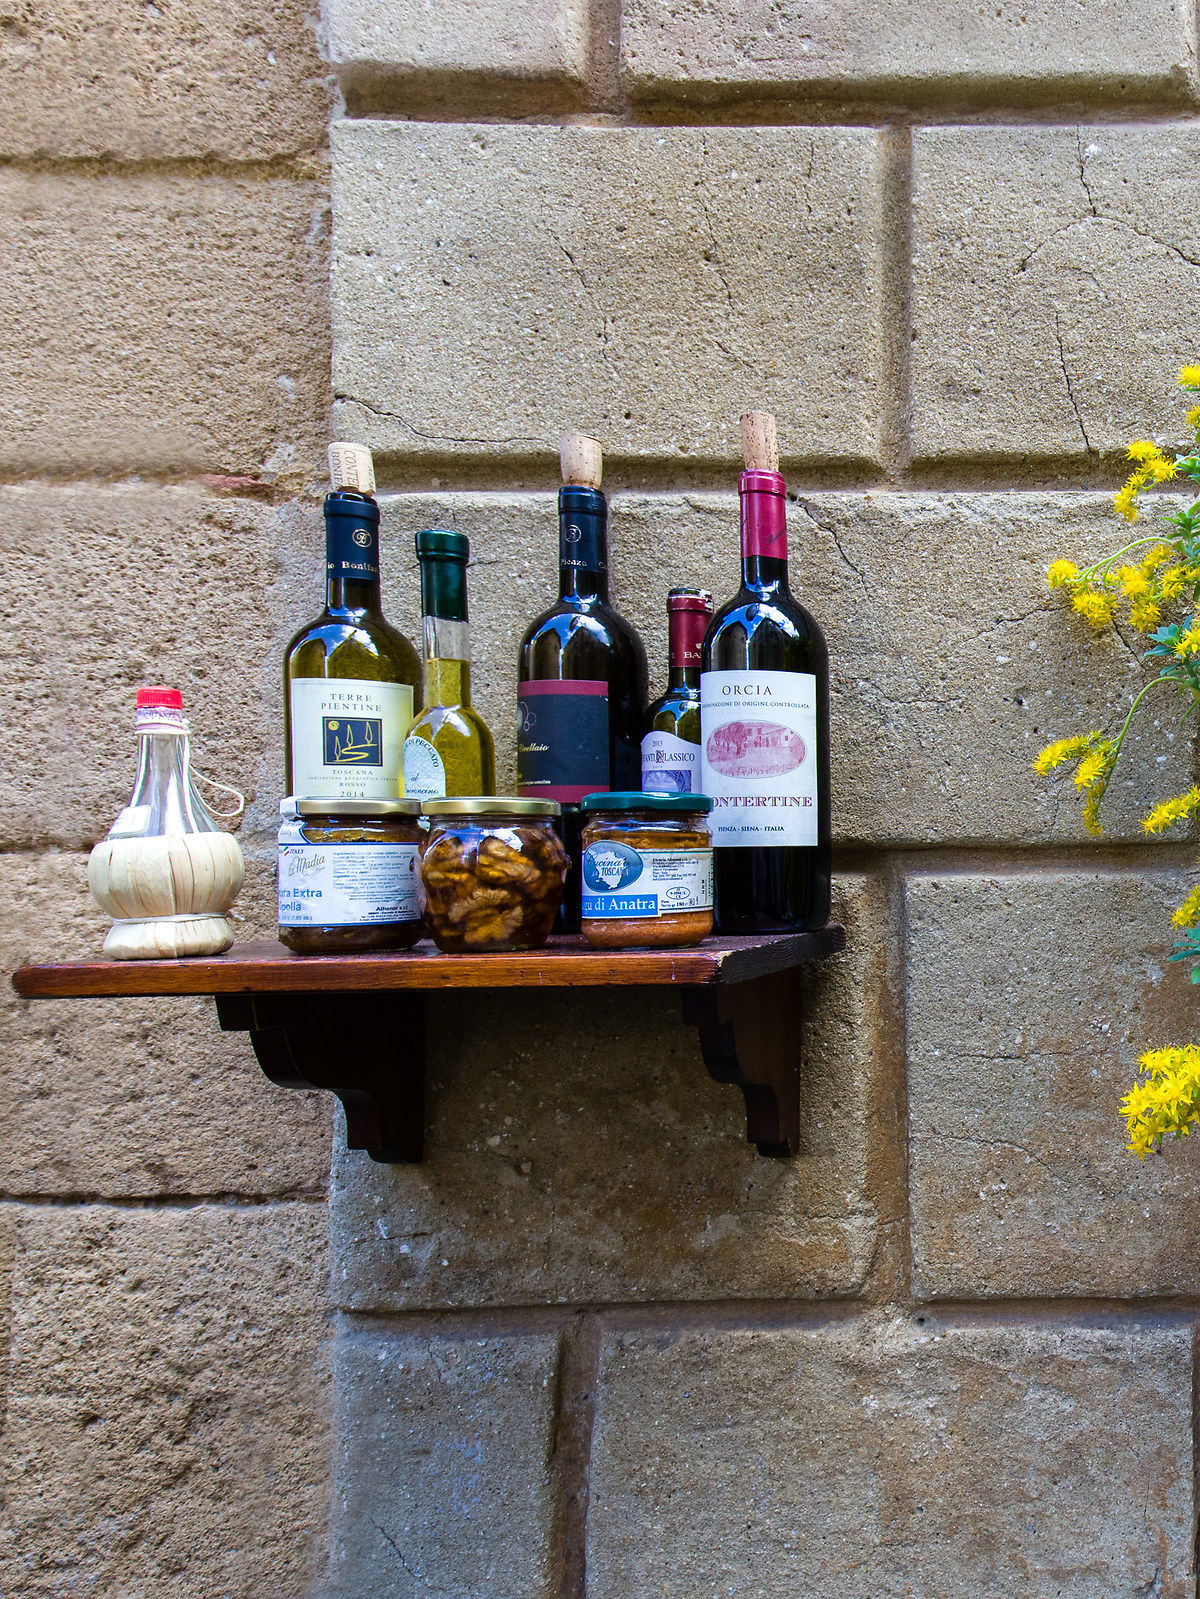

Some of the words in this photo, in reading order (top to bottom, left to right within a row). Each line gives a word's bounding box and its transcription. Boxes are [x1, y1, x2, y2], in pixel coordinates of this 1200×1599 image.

[722, 684, 772, 696] ORCIA
[329, 693, 372, 701] TERRE
[320, 702, 383, 712] PIENTINE
[769, 701, 810, 709] CONTROLLATA
[293, 888, 323, 898] Extra
[595, 898, 605, 911] di
[608, 898, 656, 911] Anatra
